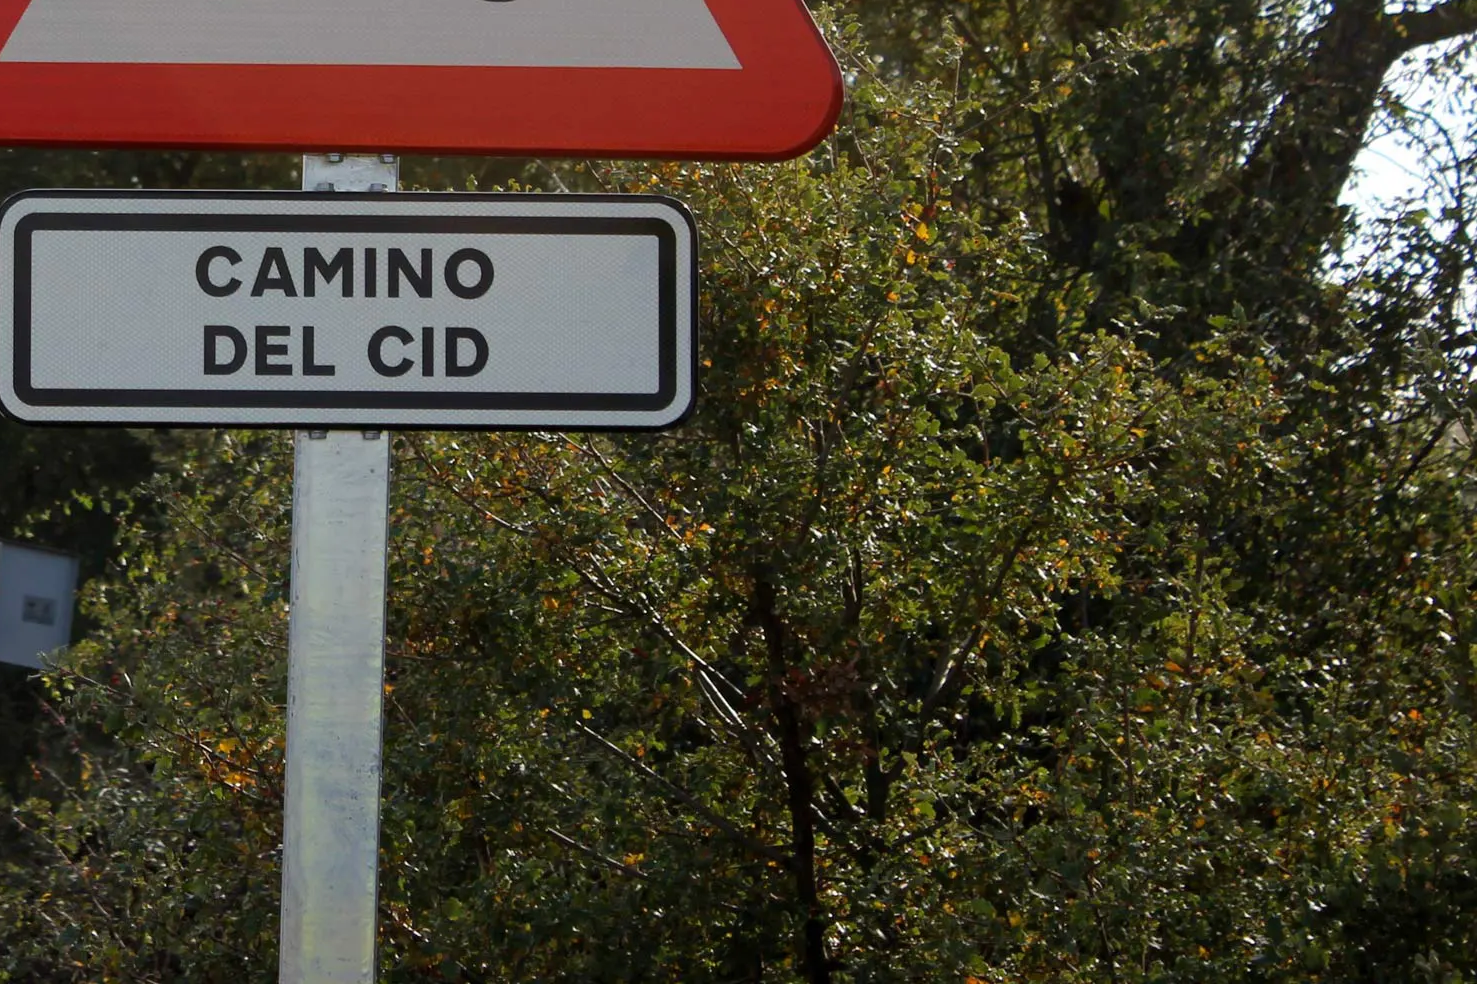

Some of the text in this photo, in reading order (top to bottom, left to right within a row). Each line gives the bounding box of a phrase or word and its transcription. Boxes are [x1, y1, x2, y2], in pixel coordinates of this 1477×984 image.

[195, 245, 495, 300] CAMINO
[203, 324, 490, 378] DEL CID
